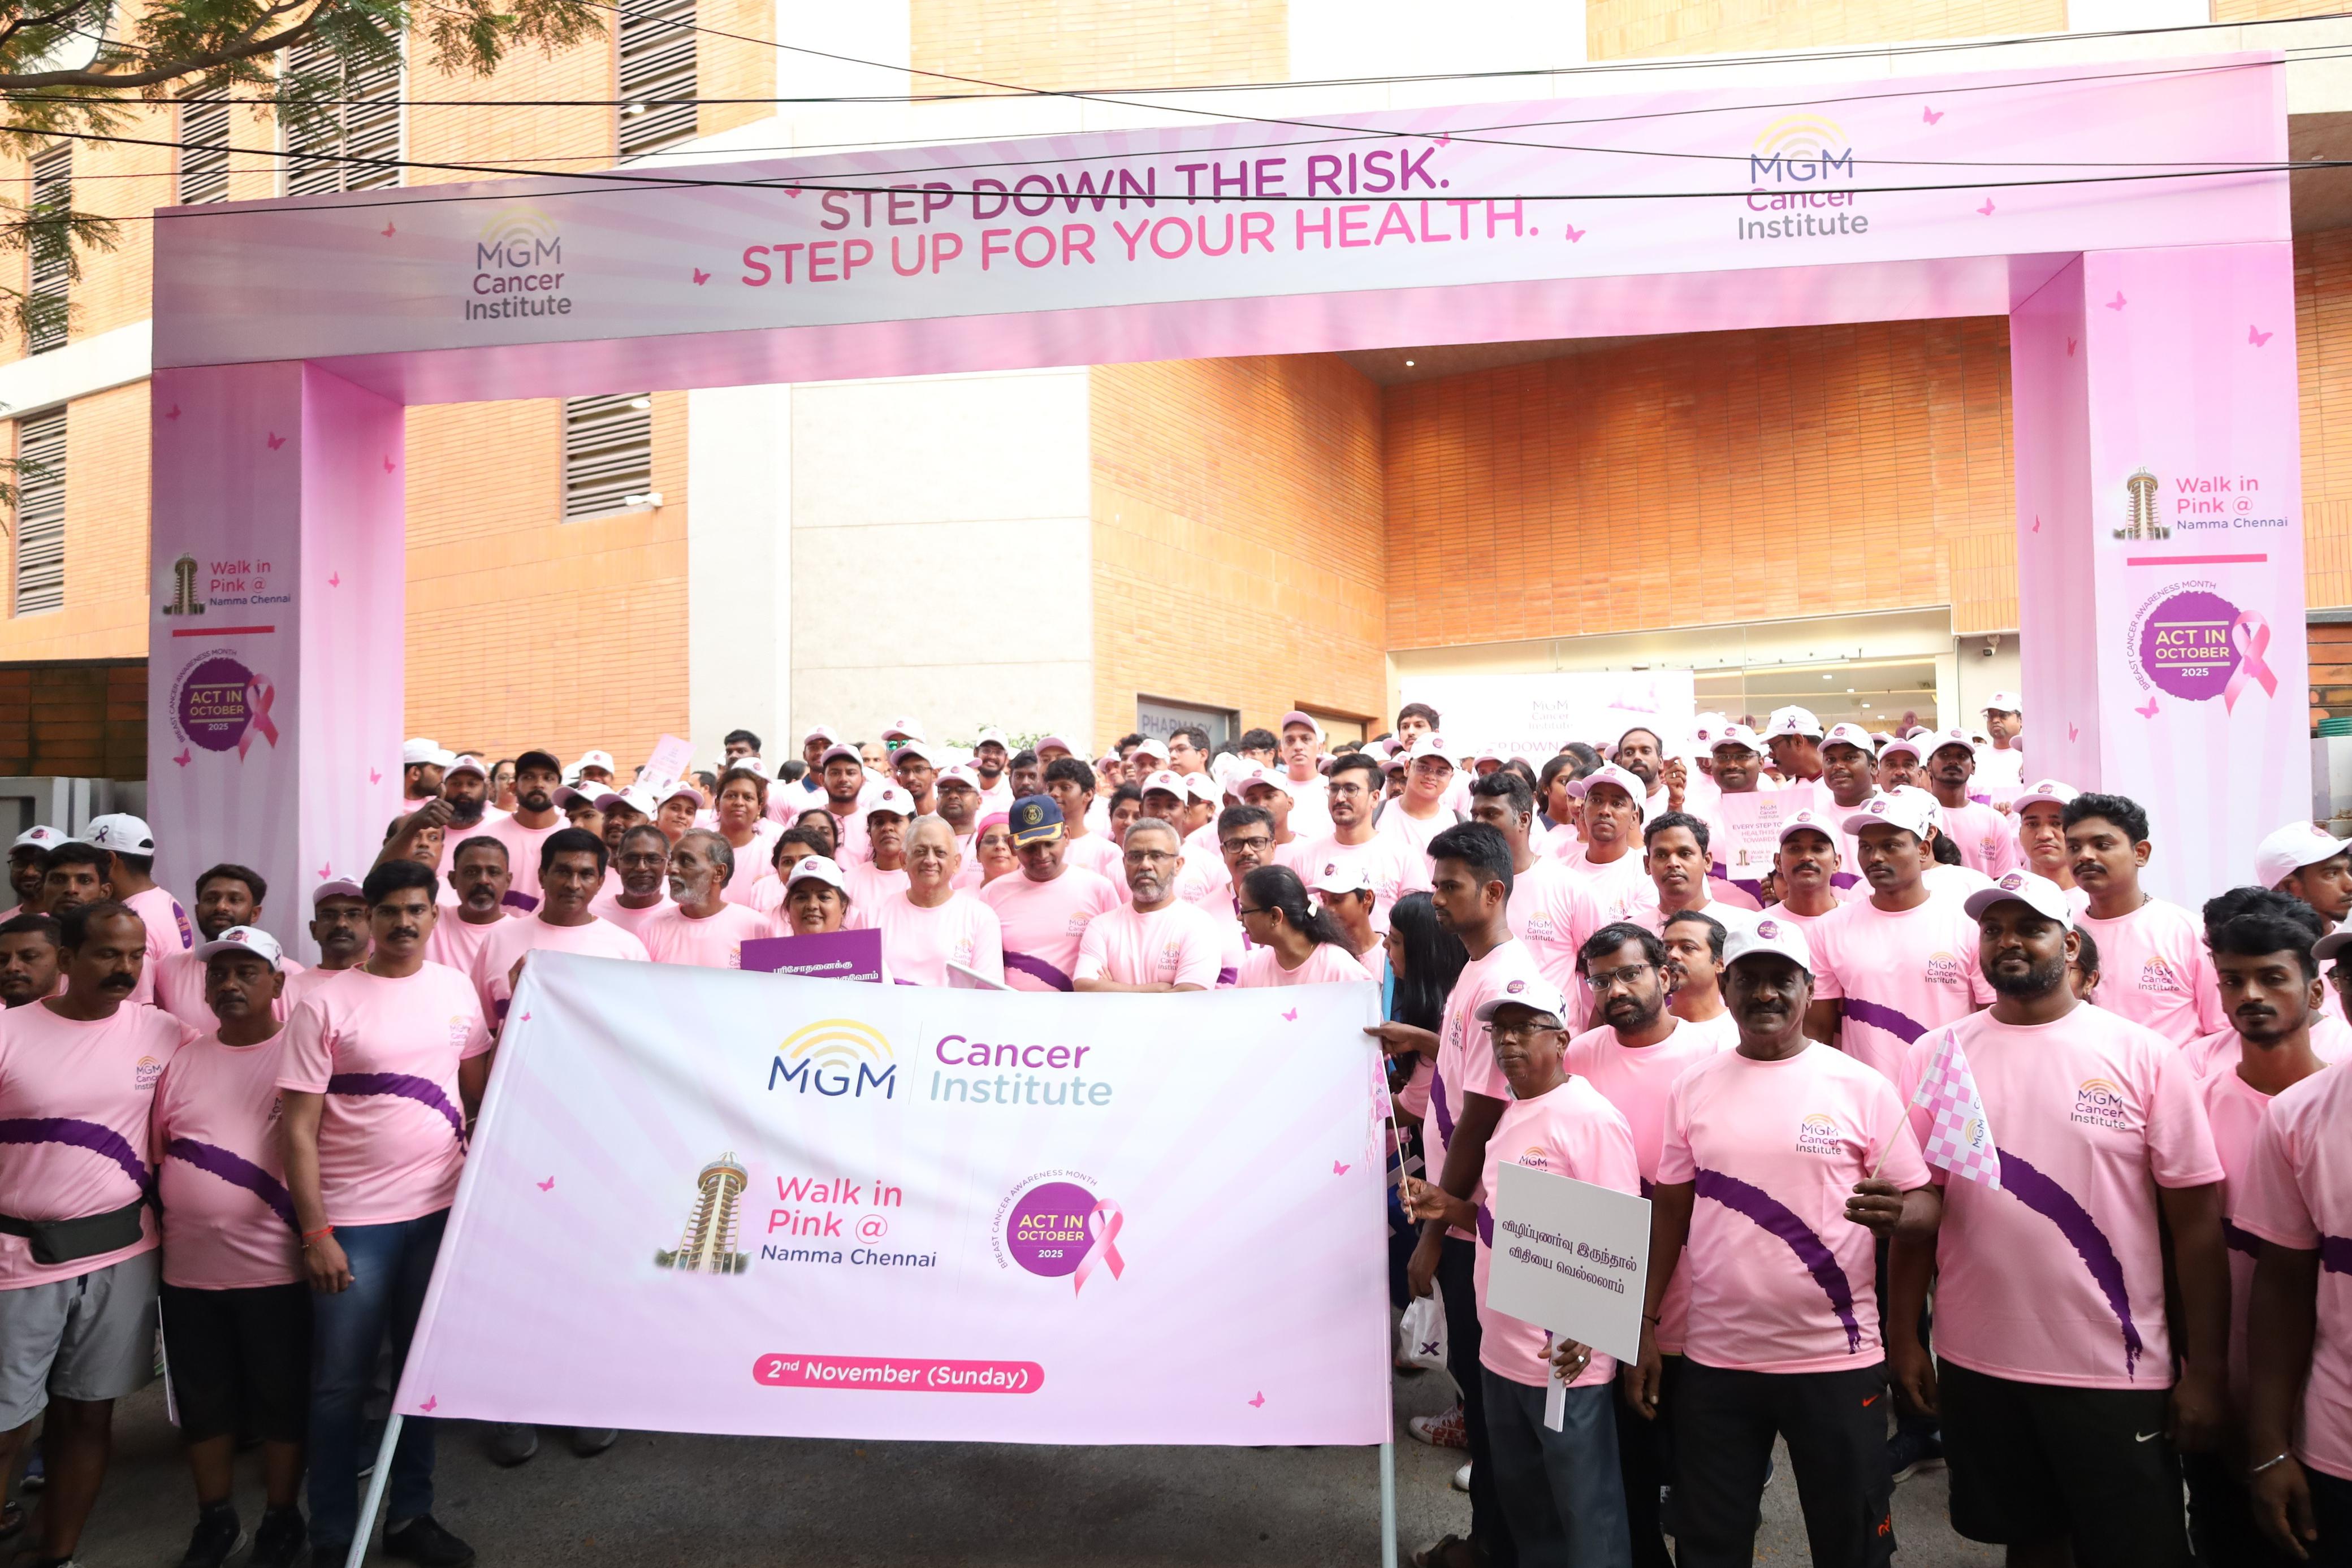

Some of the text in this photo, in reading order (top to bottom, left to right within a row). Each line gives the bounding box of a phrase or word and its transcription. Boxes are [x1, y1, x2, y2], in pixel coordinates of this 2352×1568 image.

[1751, 148, 1853, 184] MGM
[820, 147, 1450, 230] STEP DOWN THE RISK.
[1746, 188, 1856, 211] Cancer
[1739, 213, 1869, 240] Institute
[742, 194, 1539, 287] STEP UP FOR YOUR HEALTH.
[477, 236, 560, 270] MGM
[473, 272, 565, 294] Cancer
[466, 294, 572, 320] Institute
[2176, 475, 2258, 493] Walk in
[2177, 496, 2253, 516] Pink @
[2177, 517, 2288, 530] Namma Chennai
[211, 559, 271, 575] Walk in
[210, 577, 266, 592] Pink @
[210, 594, 291, 606] Namma Chennai
[2126, 581, 2216, 691] BREAST CANCER AWARENESS MONTH
[2155, 629, 2226, 645] ACT IN
[2155, 647, 2229, 659] OCTOBER
[177, 651, 211, 682] AWARENESS
[2181, 668, 2209, 677] 2025
[169, 683, 179, 714] CANCER
[191, 690, 242, 704] ACT IN
[190, 705, 244, 716] OCTOBER
[170, 717, 185, 743] BREAST
[1528, 920, 1552, 929] MGM
[1927, 969, 1957, 977] Cancer
[1929, 960, 1957, 971] MGM
[2143, 965, 2173, 978] MGM
[2139, 983, 2180, 991] Institute
[936, 1034, 1090, 1069] Cancer
[136, 1064, 162, 1075] MGM
[768, 1055, 897, 1099] MGM
[931, 1070, 1113, 1106] Institute
[2078, 1090, 2122, 1108] MGM
[2076, 1103, 2124, 1117] Cancer
[1801, 1123, 1838, 1136] MGM
[2070, 1112, 2126, 1129] Institute
[1800, 1134, 1840, 1145] Cancer
[1972, 1119, 1984, 1148] MGM
[1796, 1143, 1841, 1155] Institute
[1519, 1155, 1547, 1167] MGM
[777, 1176, 902, 1207] Walk in
[768, 1209, 888, 1244] Pink @
[992, 1169, 1098, 1268] BREAST CANCER AWARENESS MONTH
[1019, 1214, 1084, 1228] ACT IN
[1018, 1231, 1084, 1241] OCTOBER
[1502, 1220, 1637, 1272] விழிப்புணர்வு இருந்தால்
[760, 1244, 936, 1267] Namma Chennai
[1509, 1246, 1624, 1294] விதியை வெல்லலாம்
[767, 1360, 1028, 1389] 2nd November (Sunday)
